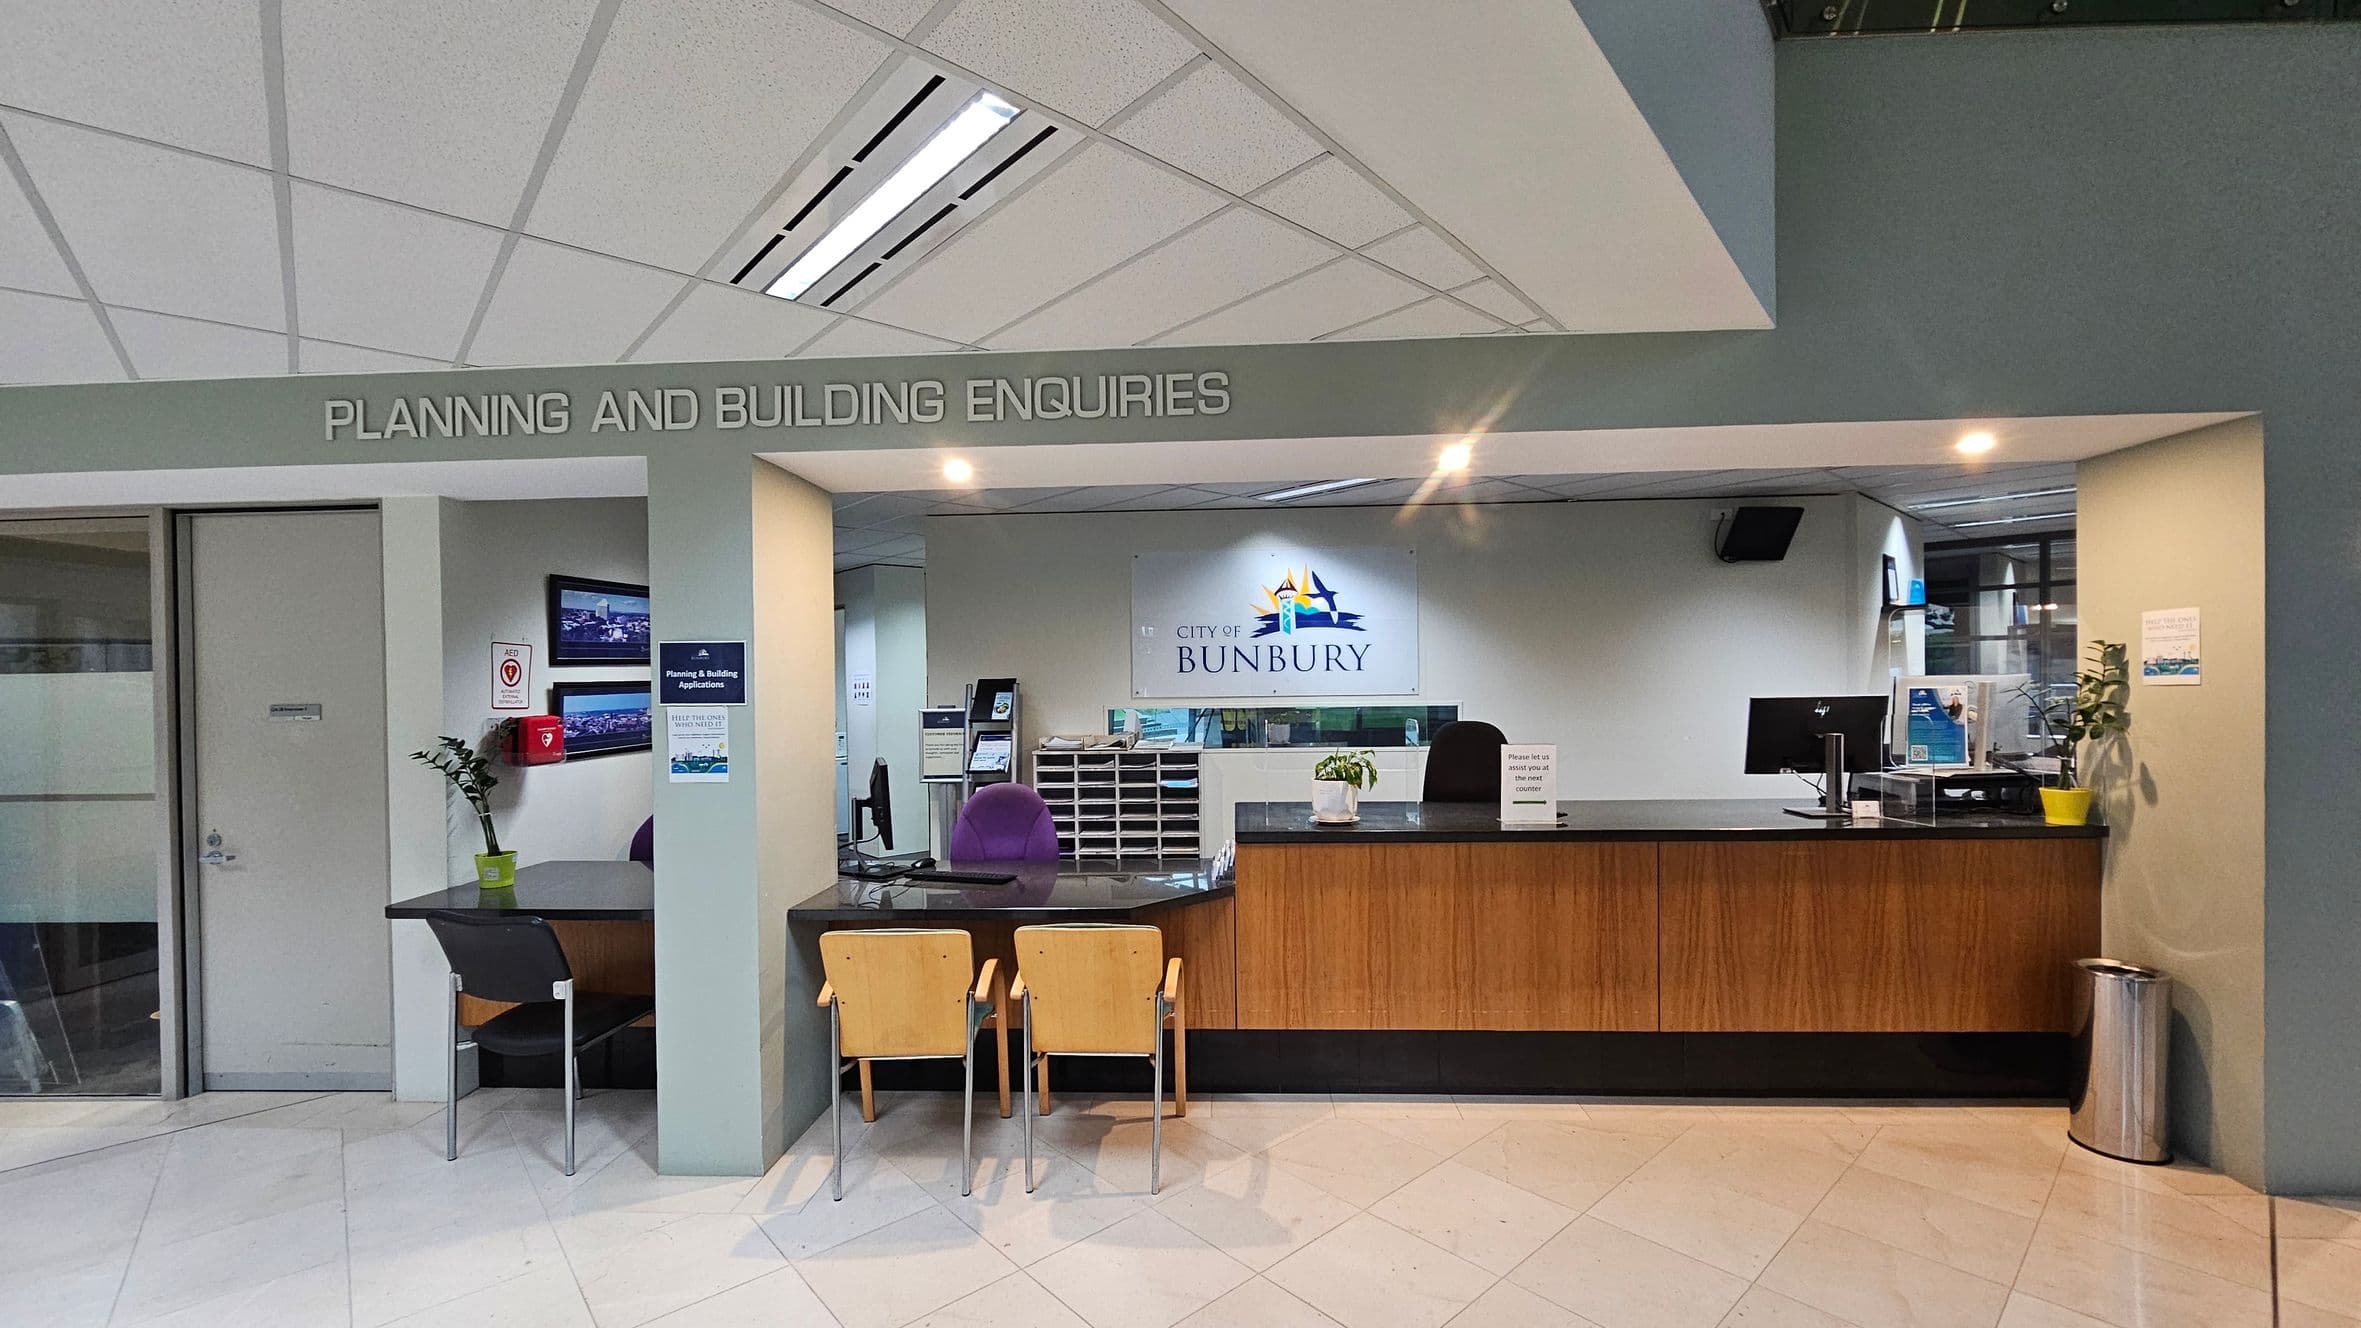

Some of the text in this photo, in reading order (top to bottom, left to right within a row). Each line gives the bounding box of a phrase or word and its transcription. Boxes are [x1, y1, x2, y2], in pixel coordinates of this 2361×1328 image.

[324, 371, 1232, 441] PLANNING AND BUILDING ENQUIRIES
[1176, 625, 1241, 639] CITY OF
[504, 649, 519, 657] AED
[1176, 643, 1372, 674] BUNBURY
[666, 670, 697, 679] Planning
[706, 670, 738, 679] Building
[679, 681, 724, 690] Applications
